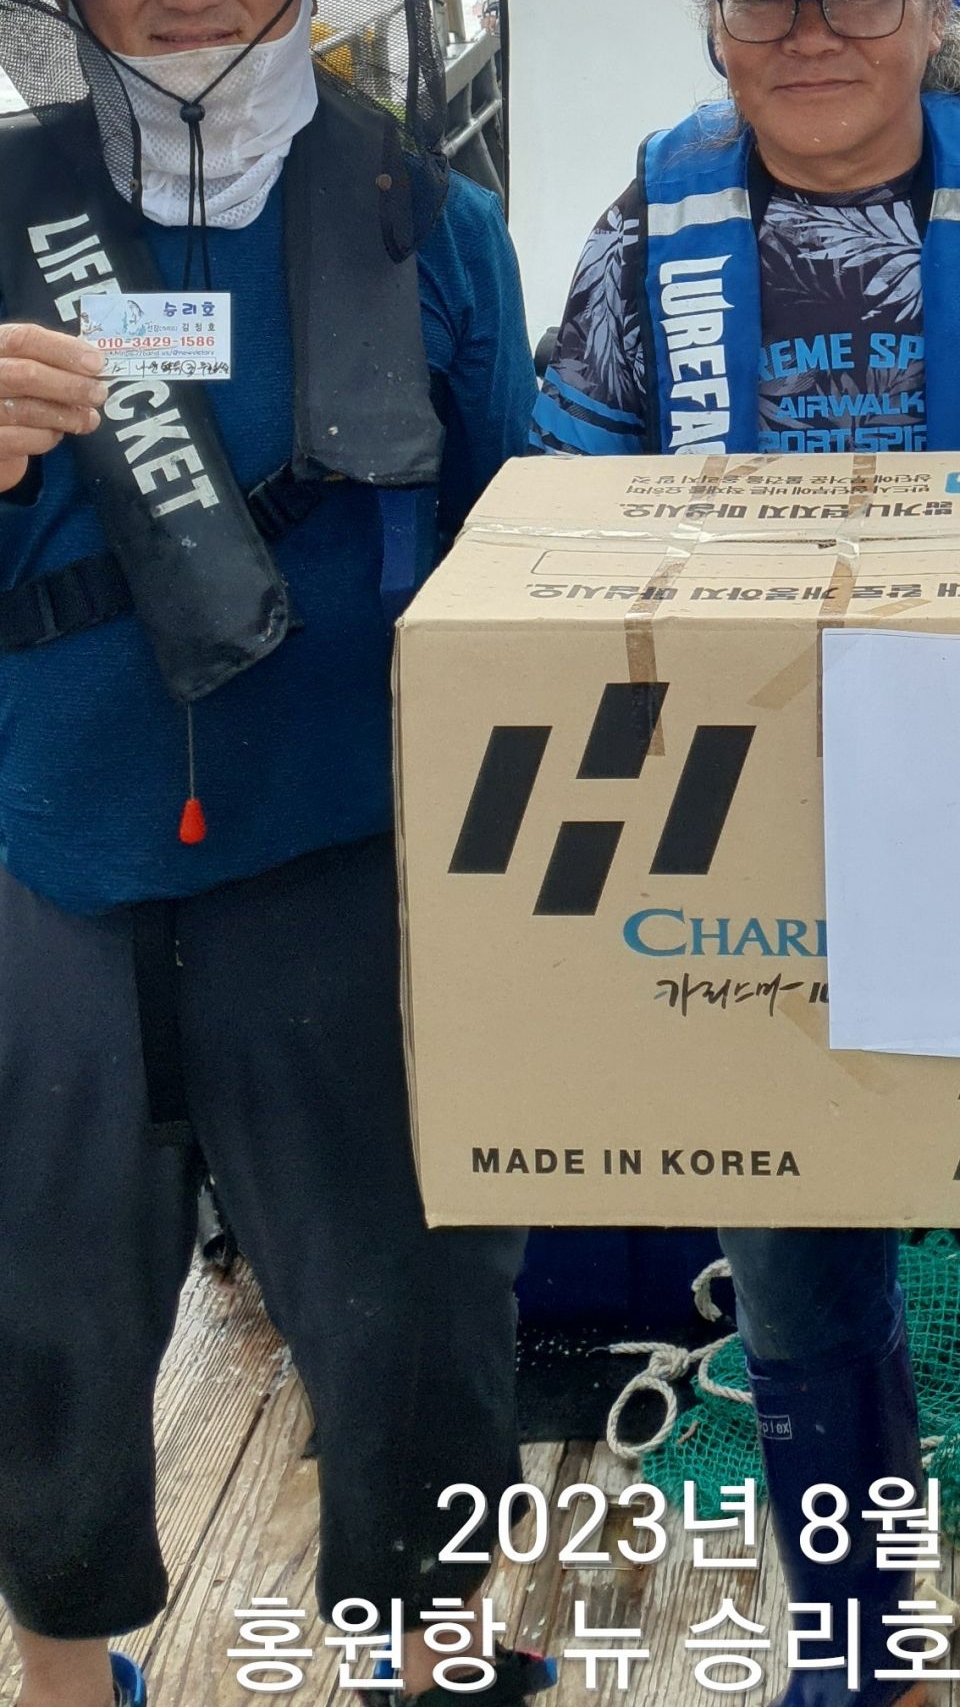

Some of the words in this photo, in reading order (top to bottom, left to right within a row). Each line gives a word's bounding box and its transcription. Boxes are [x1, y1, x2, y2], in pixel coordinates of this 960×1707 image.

[98, 336, 215, 348] 010-3429-1586
[659, 254, 735, 454] LUREFA
[776, 392, 925, 419] AIRWALK
[472, 1146, 585, 1176] MADE
[603, 1148, 643, 1176] IN
[662, 1149, 801, 1177] KOREA
